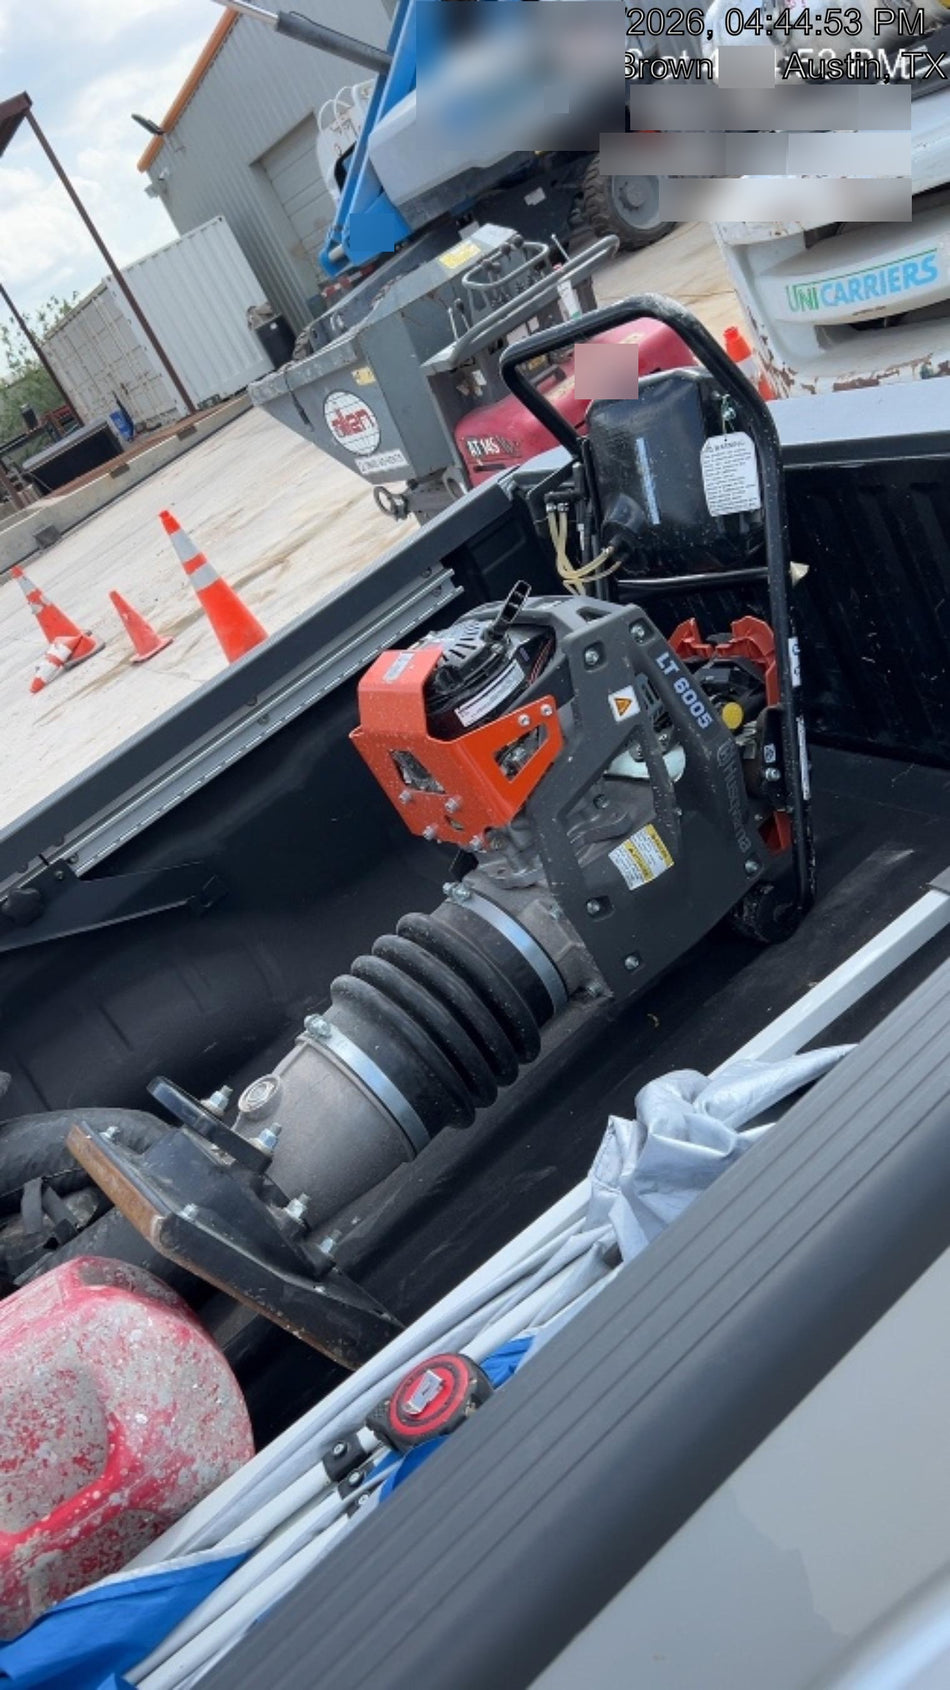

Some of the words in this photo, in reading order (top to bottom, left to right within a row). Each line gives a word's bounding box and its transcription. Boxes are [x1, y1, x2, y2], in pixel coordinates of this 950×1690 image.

[785, 252, 939, 312] UNICARRIERS
[656, 652, 680, 674] LT
[674, 677, 713, 729] 6005
